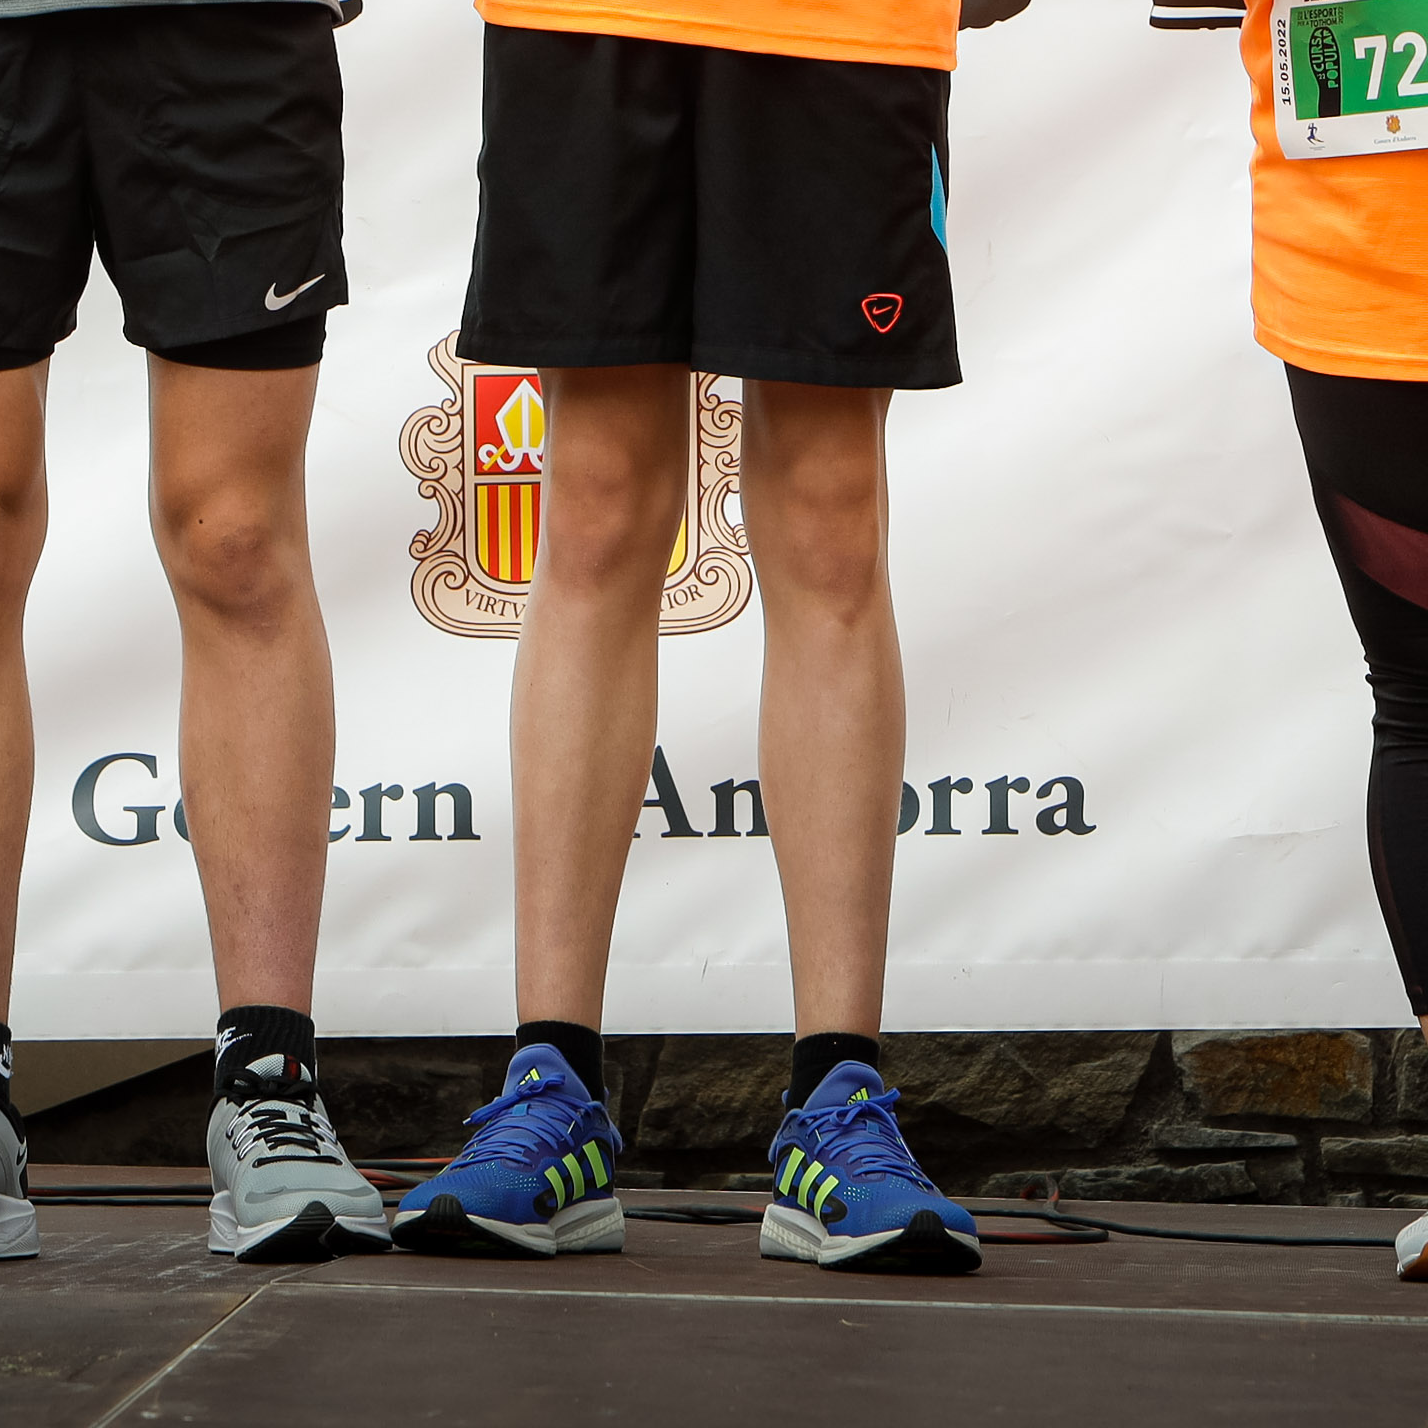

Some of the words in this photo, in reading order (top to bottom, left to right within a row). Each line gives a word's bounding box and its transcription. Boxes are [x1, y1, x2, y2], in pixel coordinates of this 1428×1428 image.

[1303, 7, 1338, 21] L'ESPORT
[1310, 17, 1338, 28] TOTHOM
[1277, 18, 1292, 107] 15.05.2022
[1311, 29, 1325, 73] CURSA
